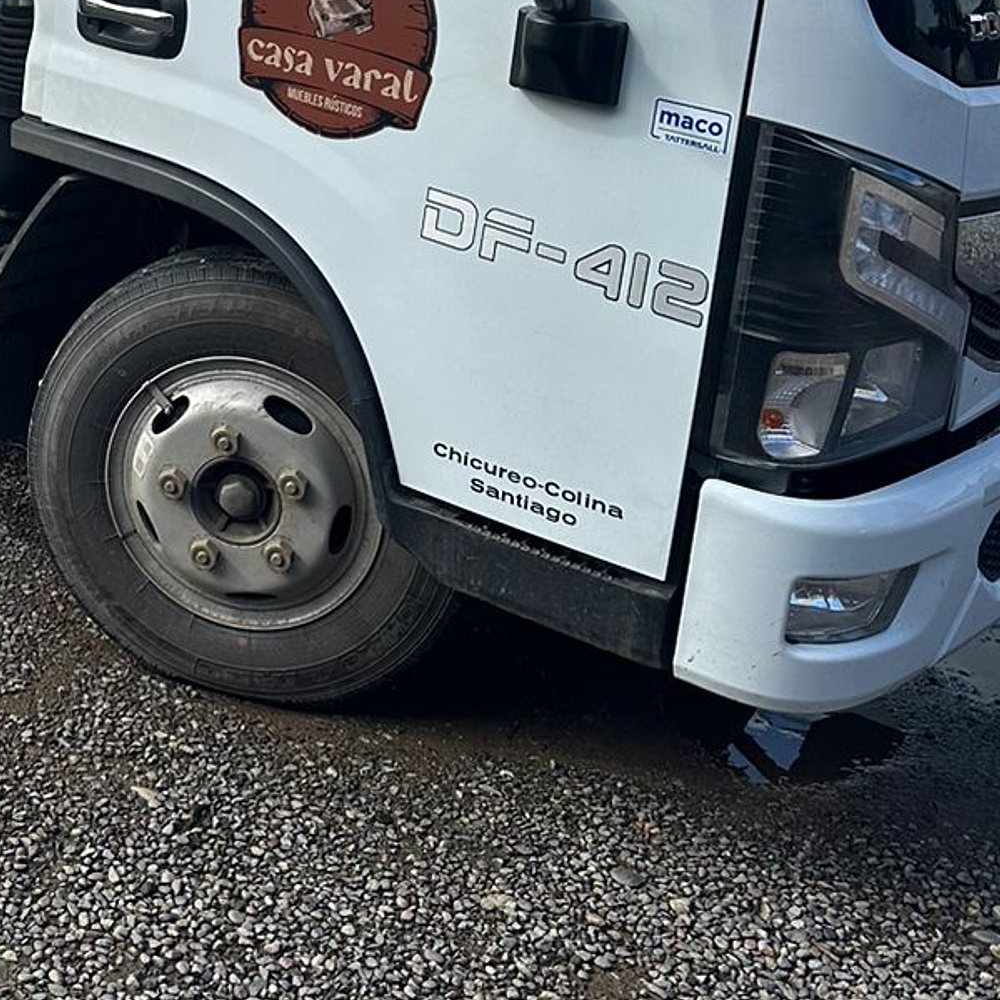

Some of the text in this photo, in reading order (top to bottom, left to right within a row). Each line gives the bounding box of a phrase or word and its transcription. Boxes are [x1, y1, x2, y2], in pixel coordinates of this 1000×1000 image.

[246, 38, 419, 104] casa varal
[286, 86, 325, 109] MUEBLES
[659, 110, 723, 136] maco
[420, 186, 710, 328] DF-412
[433, 442, 624, 520] Chicureo-Colina
[470, 478, 577, 526] Santiago
